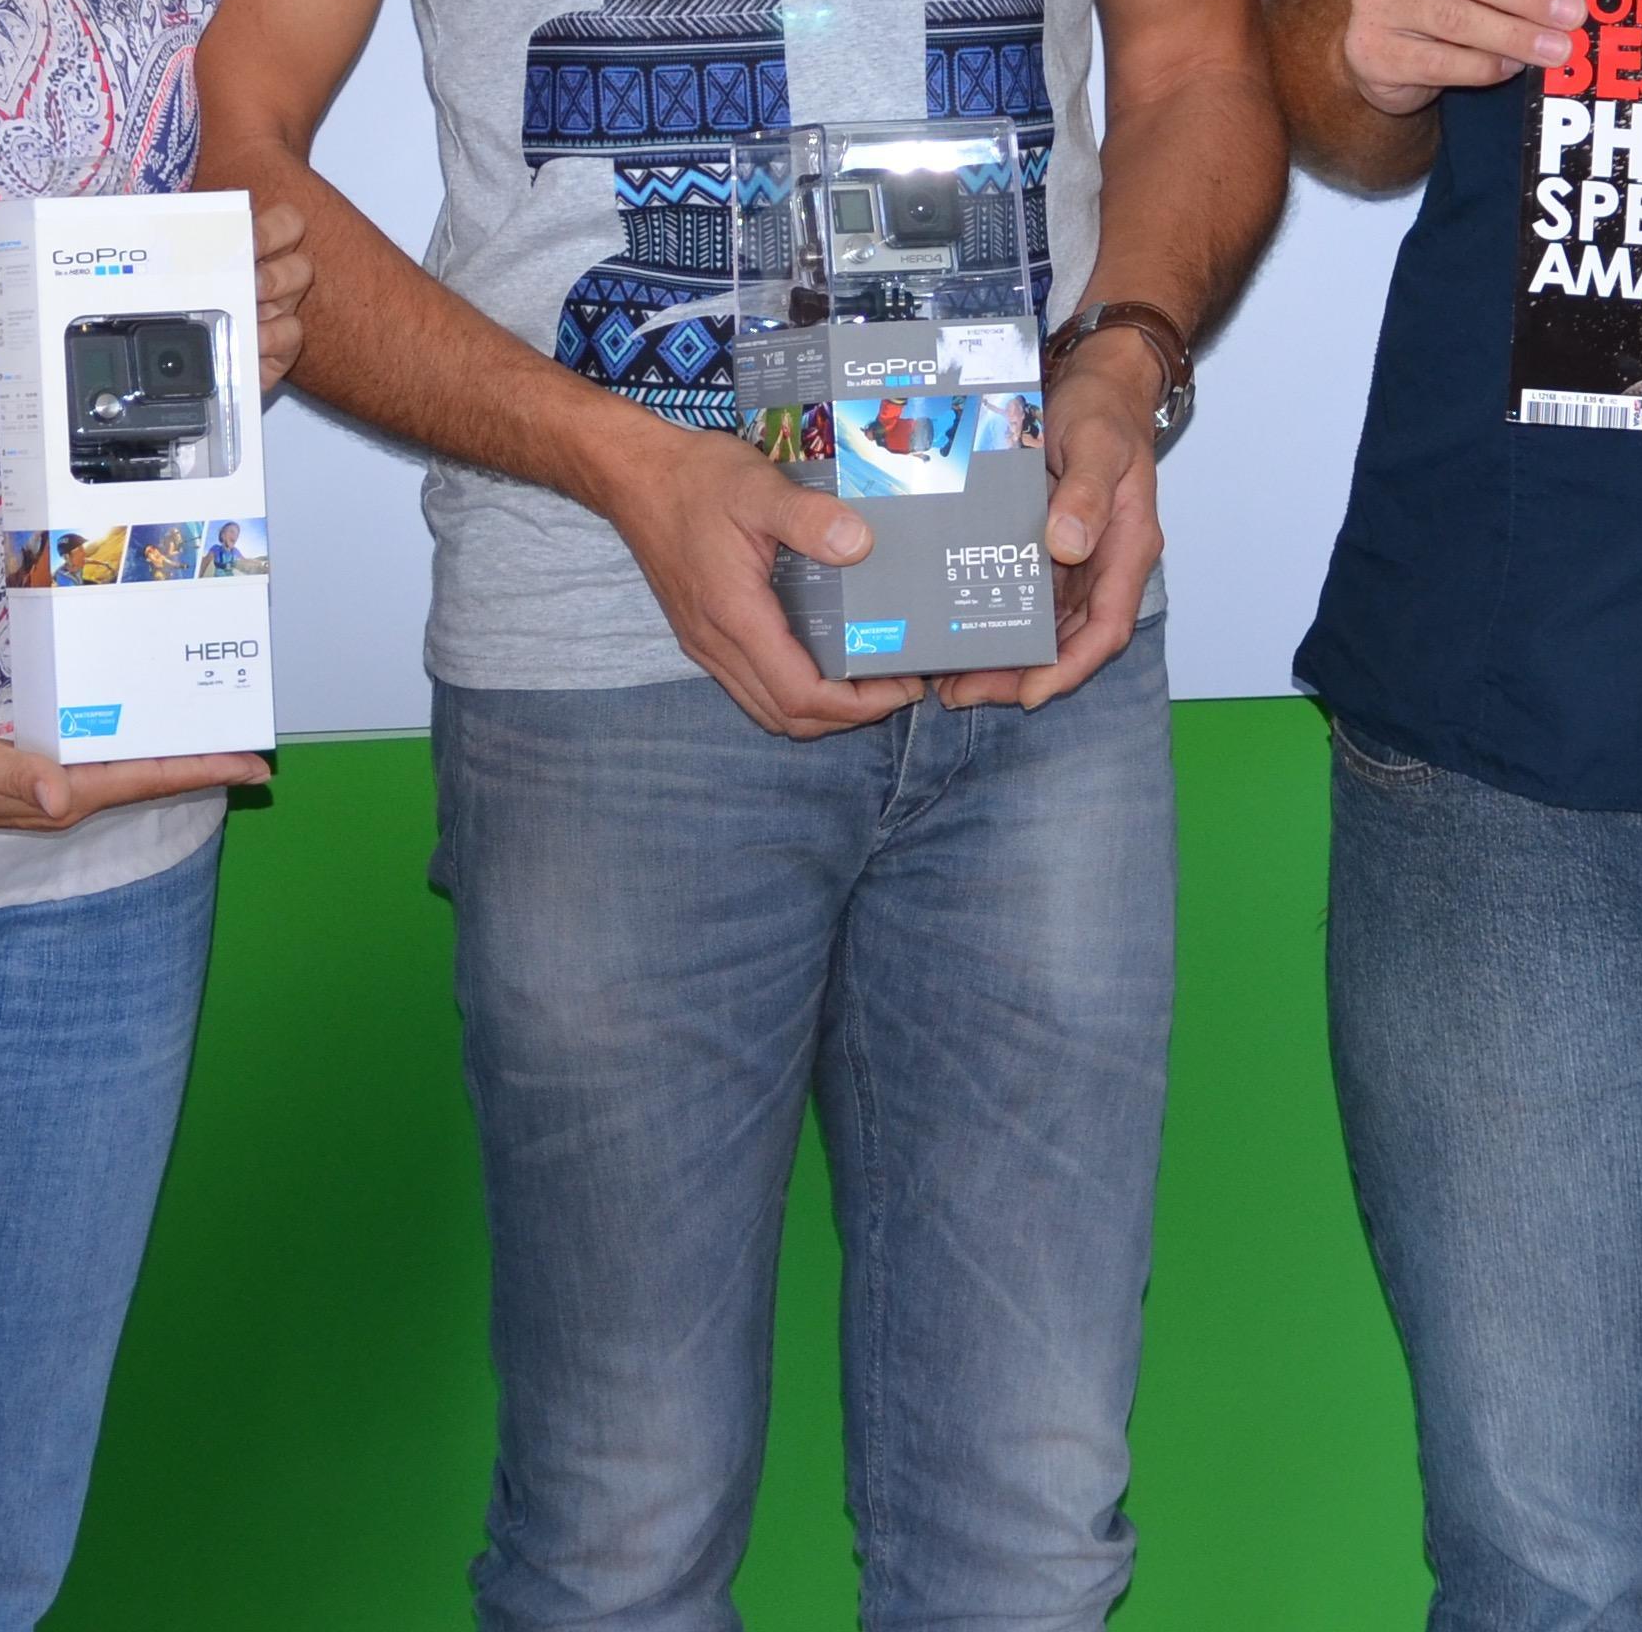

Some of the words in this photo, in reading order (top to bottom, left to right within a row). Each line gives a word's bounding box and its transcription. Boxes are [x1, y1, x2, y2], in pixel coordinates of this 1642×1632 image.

[53, 248, 147, 265] GoPro
[901, 254, 942, 264] HERO4
[844, 358, 937, 376] GoPro
[946, 543, 1040, 566] HERO4
[947, 564, 1040, 581] SILVER
[186, 640, 258, 661] HERO
